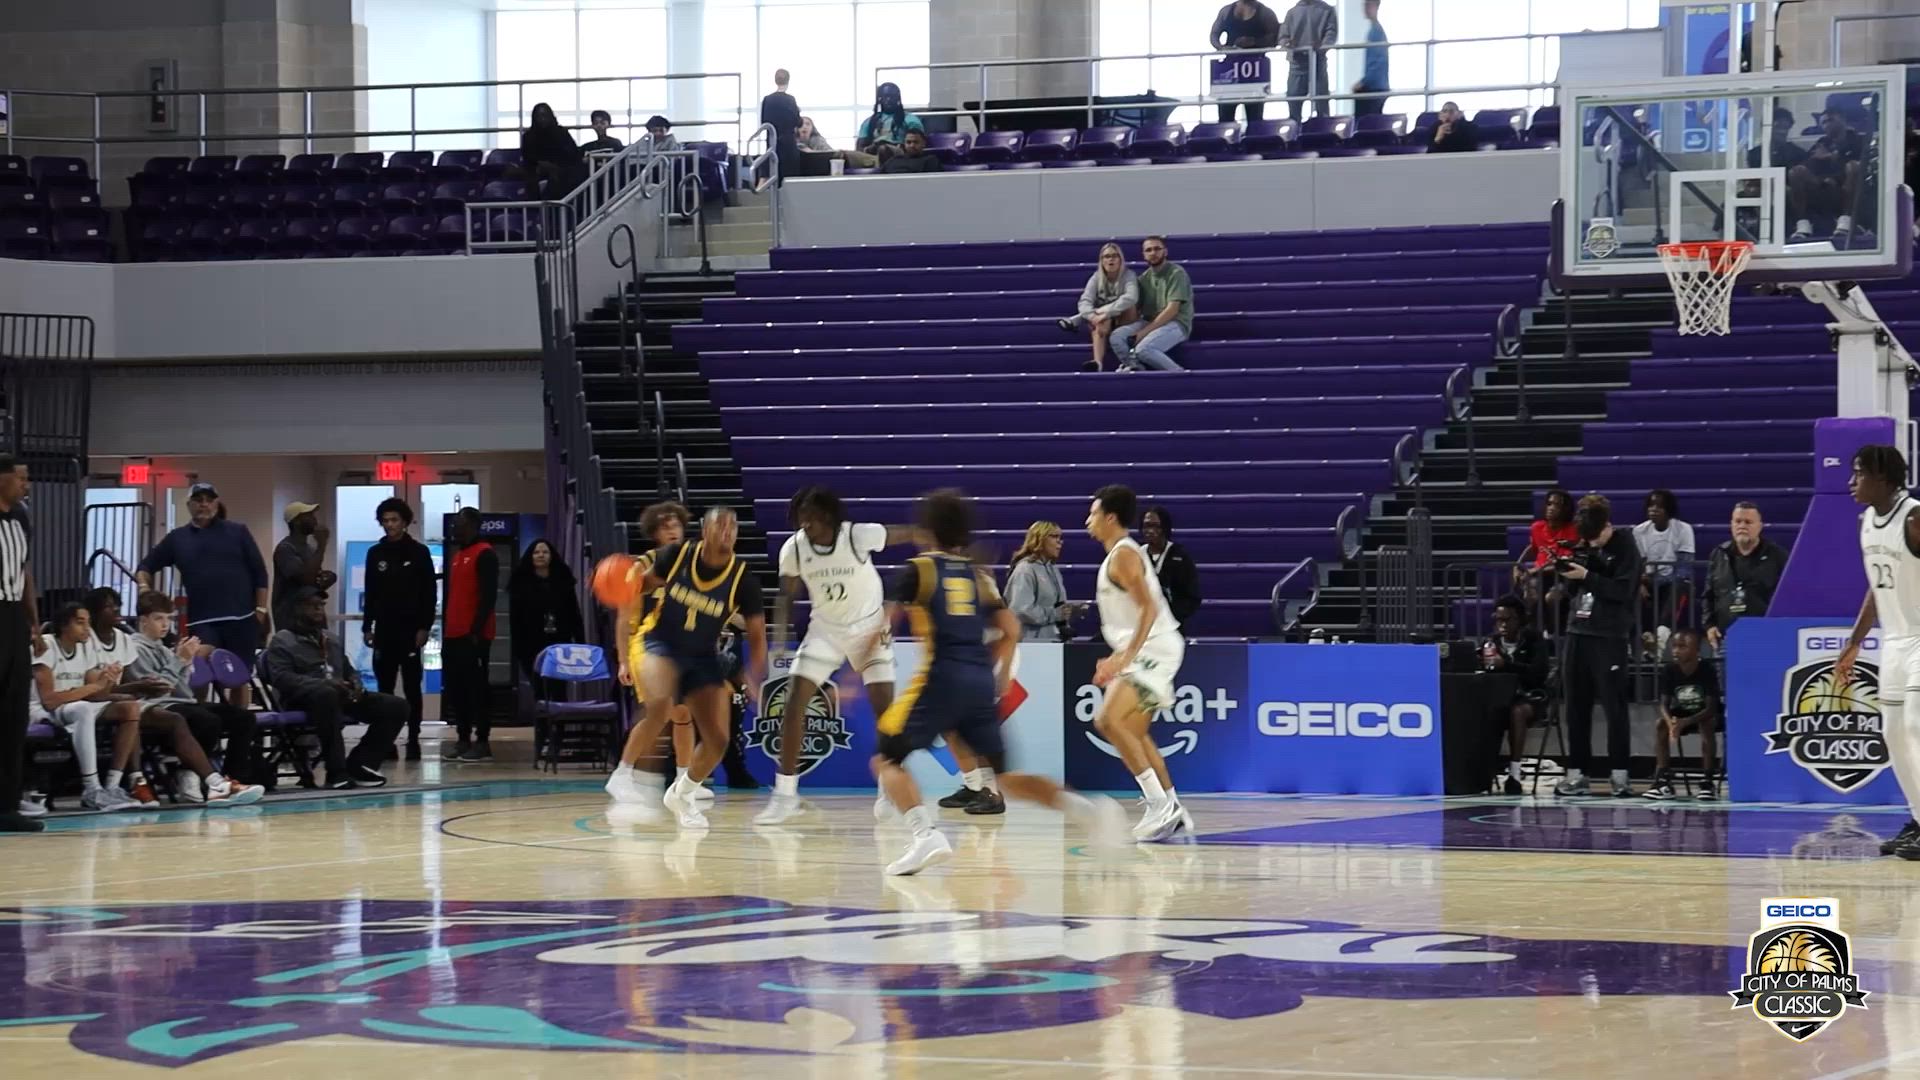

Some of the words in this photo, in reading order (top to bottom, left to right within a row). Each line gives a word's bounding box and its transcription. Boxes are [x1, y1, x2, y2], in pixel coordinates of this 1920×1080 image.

[1233, 61, 1260, 78] 101
[382, 462, 403, 480] EXIT
[480, 520, 505, 532] epsi
[1872, 563, 1895, 589] 23
[820, 582, 848, 601] 32
[942, 576, 976, 616] 2
[1075, 684, 1238, 723] aa+
[807, 717, 839, 734] PALMS
[1257, 701, 1434, 738] GEICO
[1783, 714, 1824, 735] CITY
[1827, 713, 1854, 731] OF
[1857, 714, 1883, 733] PAL
[770, 736, 824, 753] CSIC
[1803, 738, 1882, 761] CLASSIC
